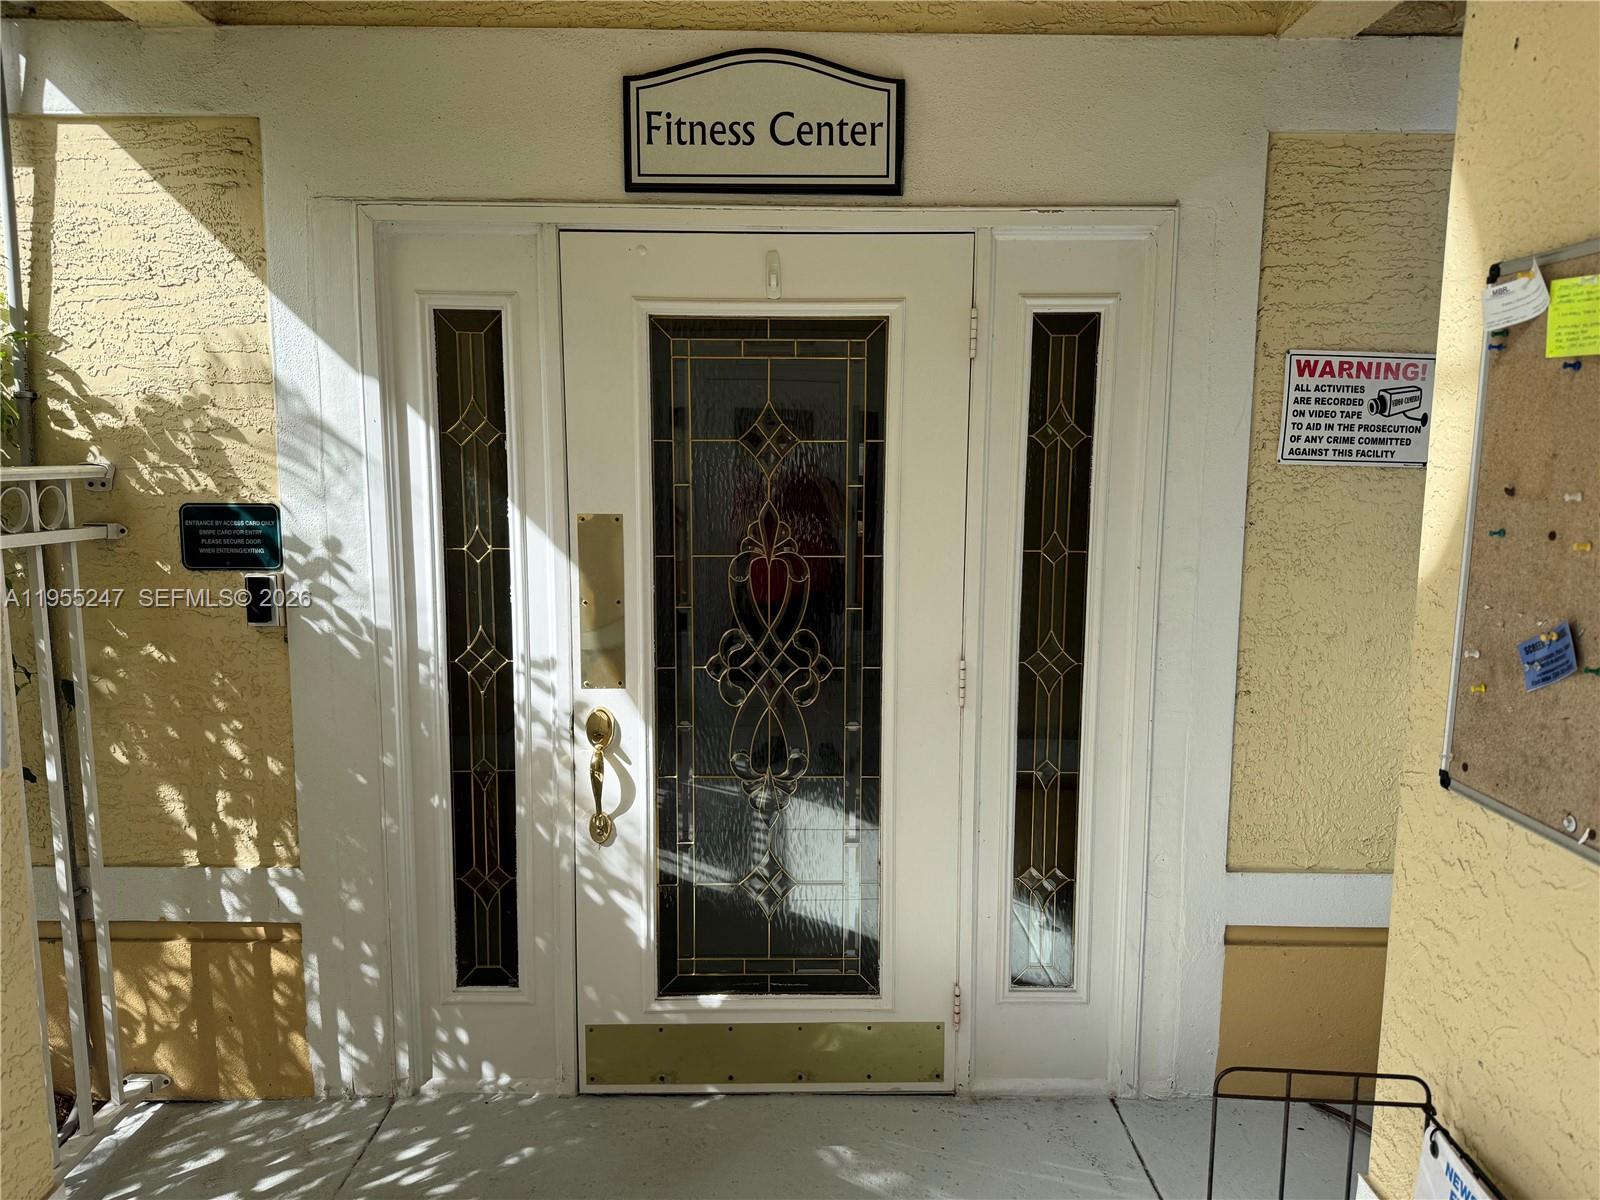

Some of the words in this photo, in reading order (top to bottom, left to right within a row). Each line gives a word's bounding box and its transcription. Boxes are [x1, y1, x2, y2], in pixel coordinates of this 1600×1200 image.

[646, 111, 755, 146] Fitness
[770, 112, 883, 146] Center
[1296, 359, 1427, 381] WARNING!
[1294, 384, 1311, 392] ALL
[1314, 384, 1365, 393] ACTIVITIES
[1315, 397, 1363, 406] RECORDED
[1340, 411, 1362, 419] TAPE
[1358, 424, 1421, 434] PROSECUTION
[1304, 436, 1324, 444] ANY
[1327, 436, 1355, 444] CRIME
[1358, 437, 1411, 446] COMMITTED
[1288, 448, 1329, 456] AGAINST
[1332, 449, 1352, 457] THIS
[1356, 449, 1395, 458] FACILITY
